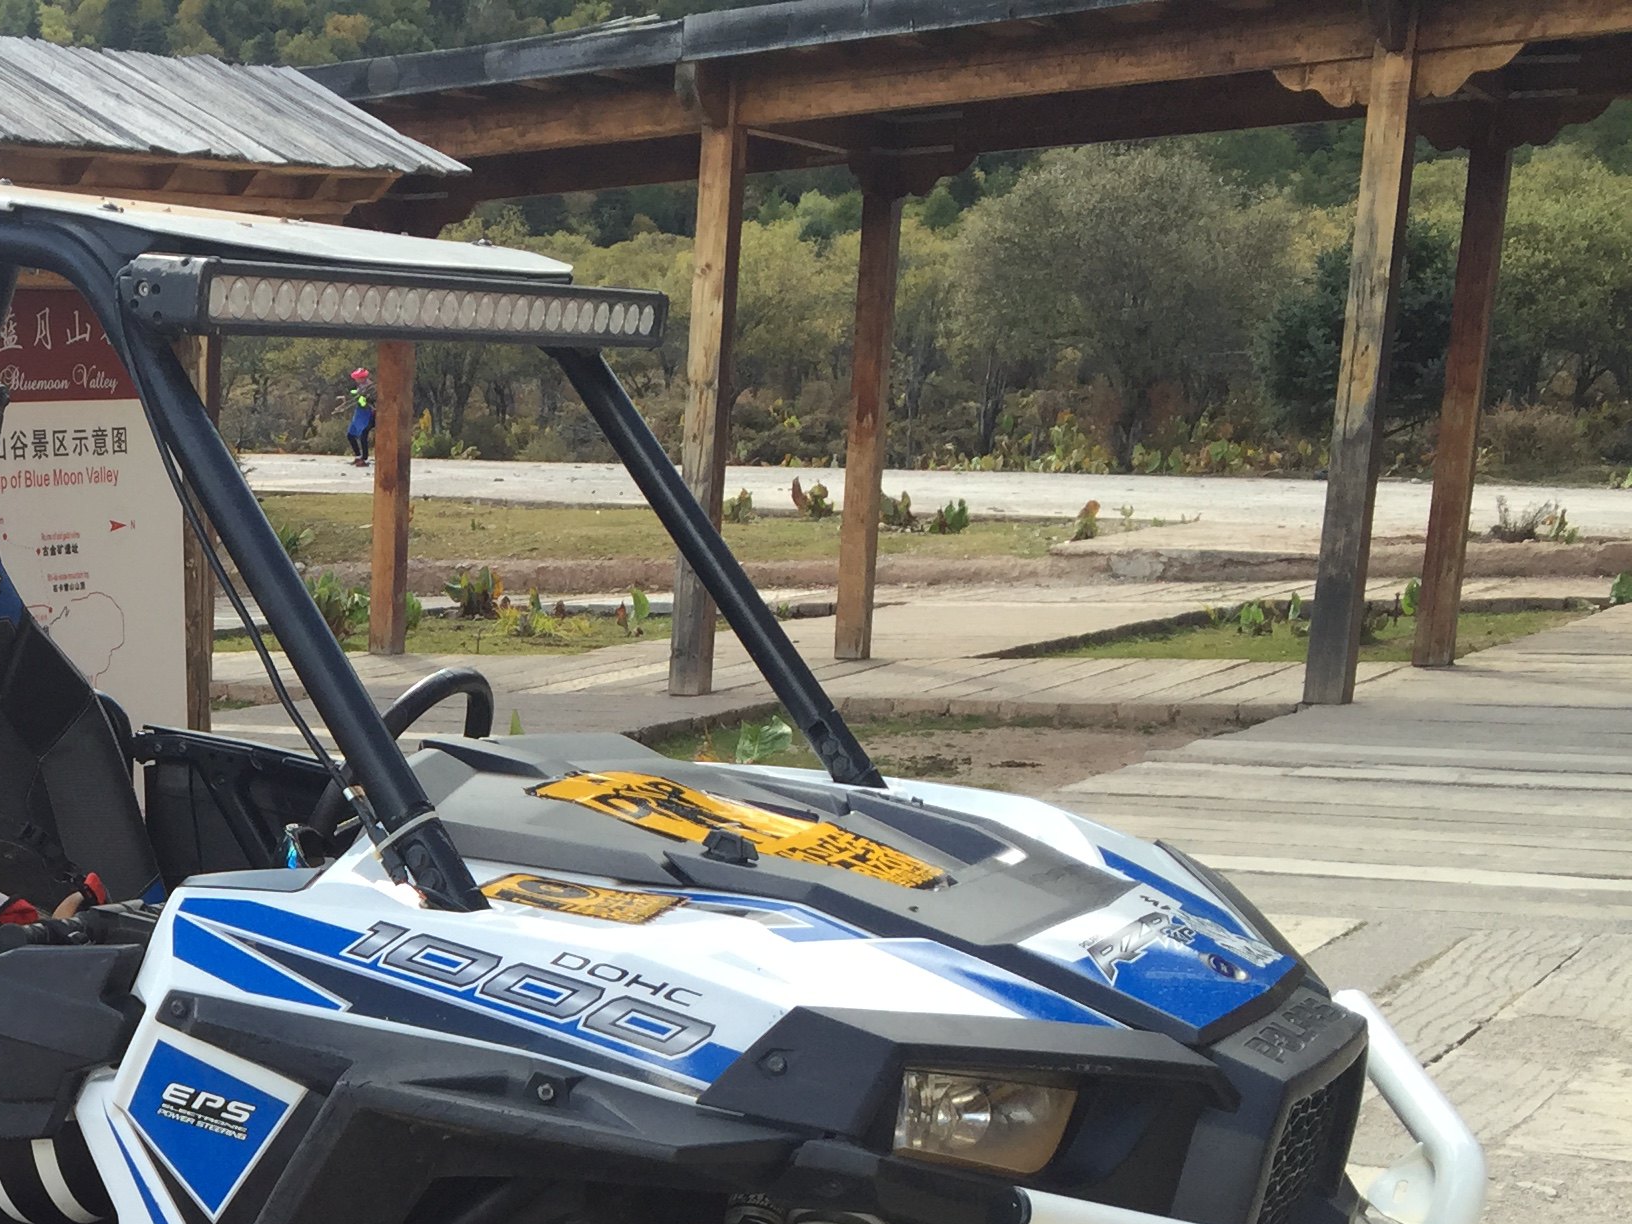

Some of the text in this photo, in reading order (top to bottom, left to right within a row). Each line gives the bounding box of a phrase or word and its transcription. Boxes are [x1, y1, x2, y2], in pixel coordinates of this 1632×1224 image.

[0, 364, 118, 394] Bluemoon Valley
[10, 470, 22, 489] of
[25, 469, 50, 488] Blue
[53, 468, 84, 486] Moon
[86, 466, 119, 487] Valley
[1086, 911, 1171, 983] RZR
[342, 921, 715, 1058] 1000
[552, 951, 703, 1008] DOHC
[161, 1103, 248, 1132] ELECTRONIC
[162, 1082, 257, 1123] EPS
[157, 1108, 248, 1141] POWER STEERING
